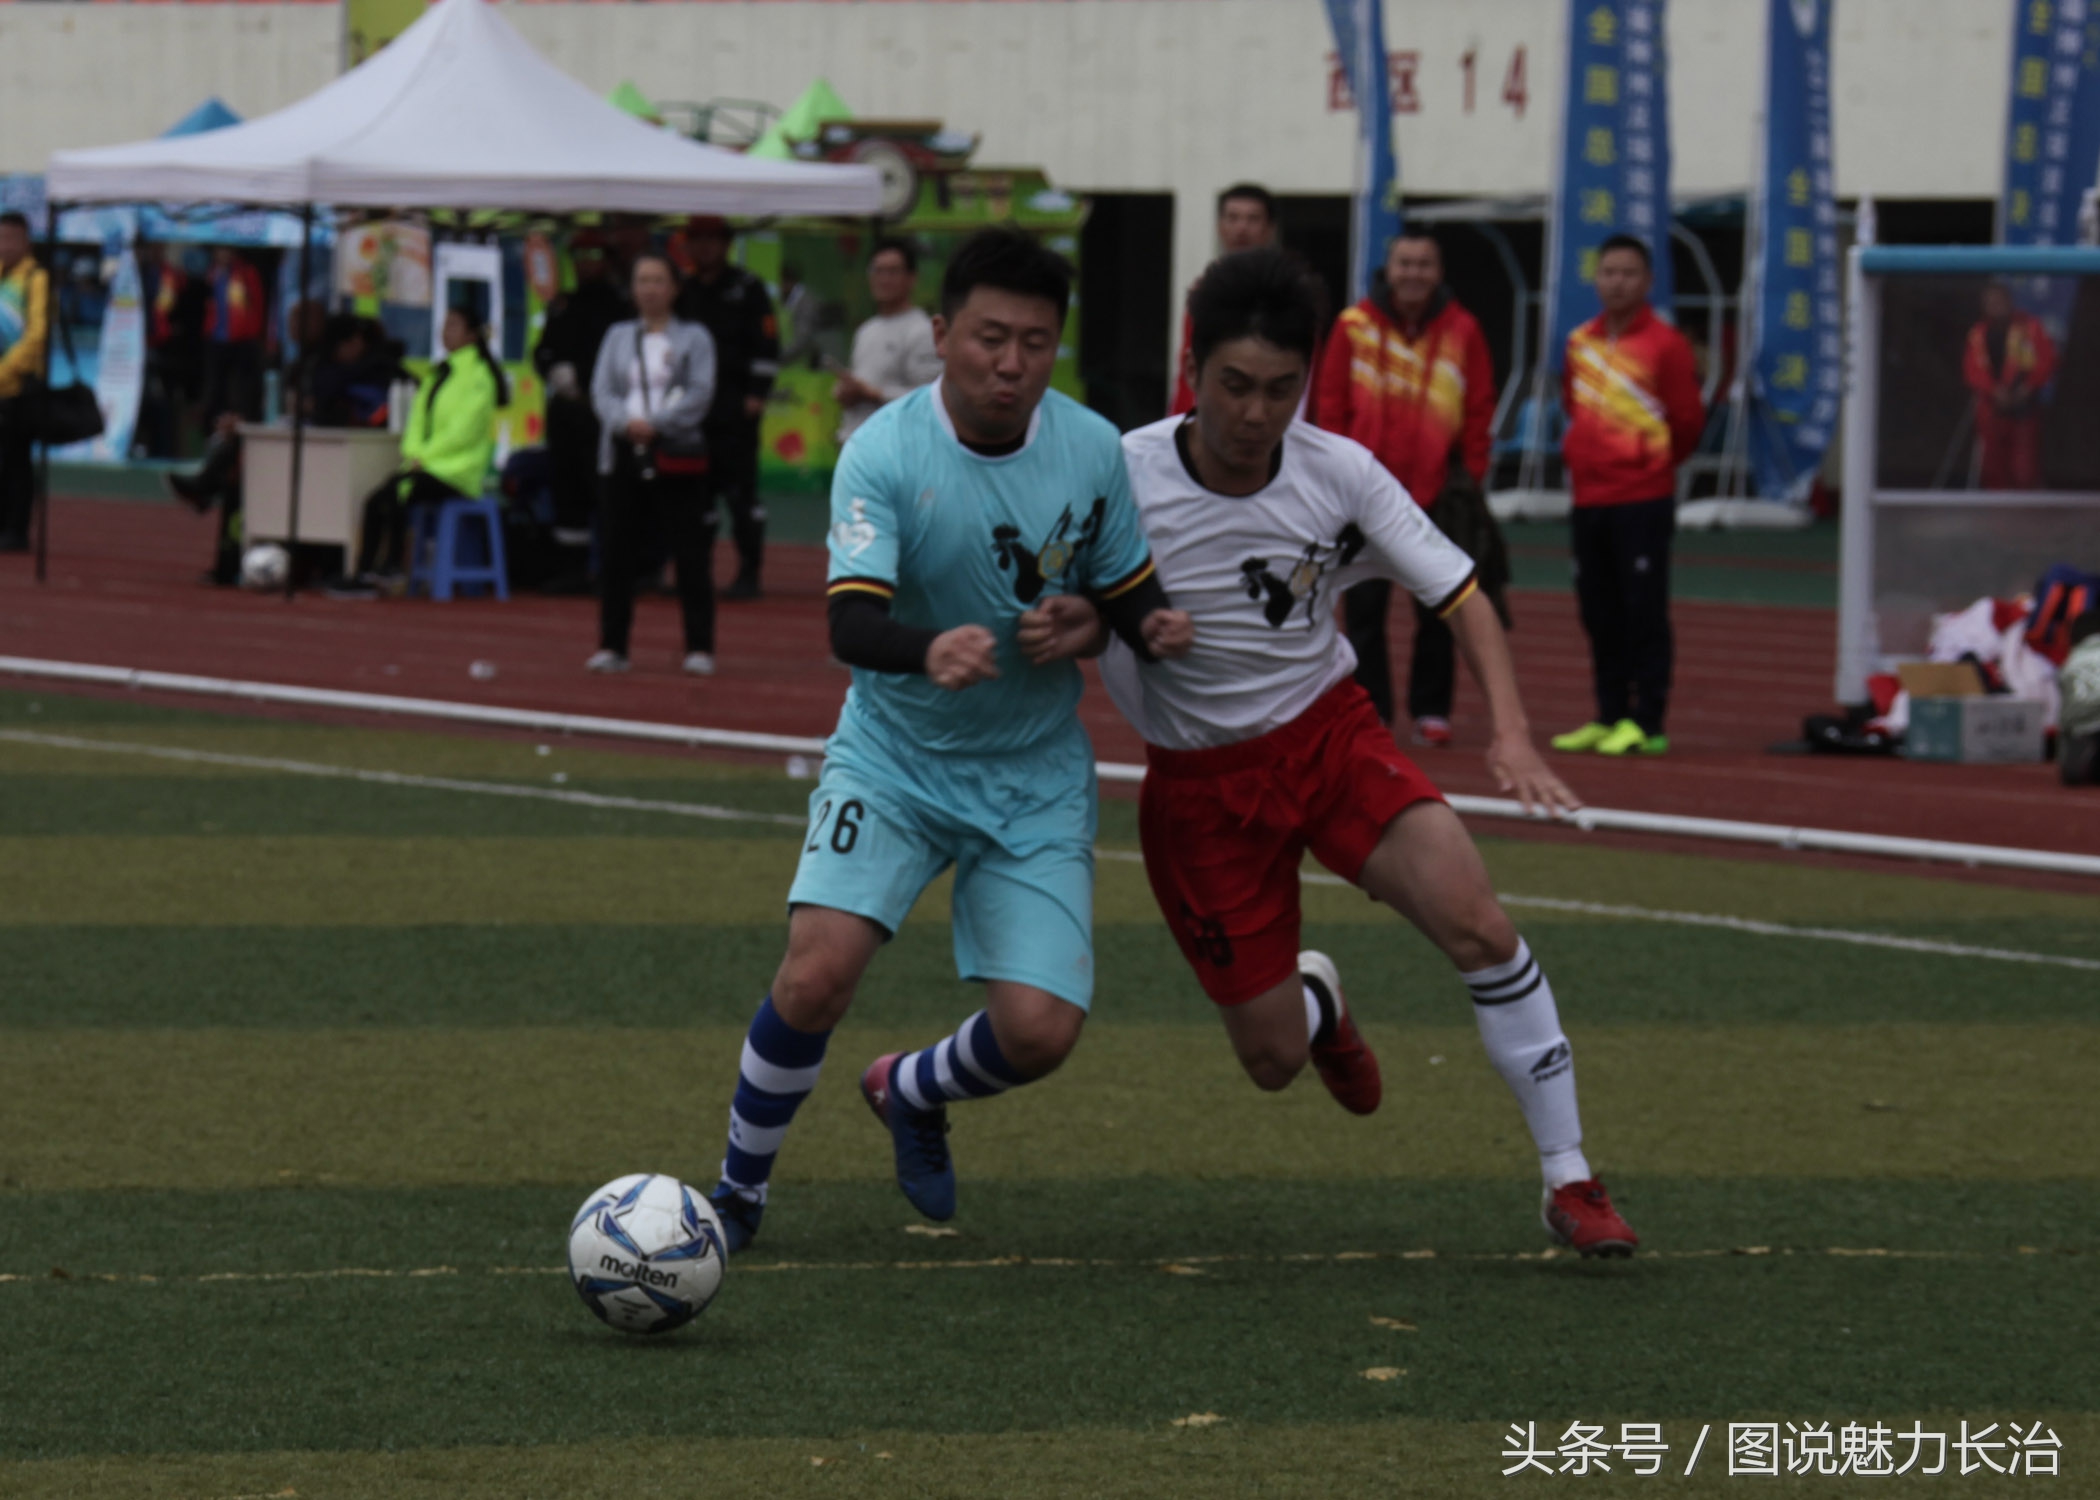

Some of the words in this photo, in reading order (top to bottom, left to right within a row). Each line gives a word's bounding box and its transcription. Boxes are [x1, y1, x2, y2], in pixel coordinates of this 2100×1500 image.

[1770, 164, 1813, 424] 全国总决
[805, 799, 865, 854] 26
[600, 1254, 679, 1289] molten
